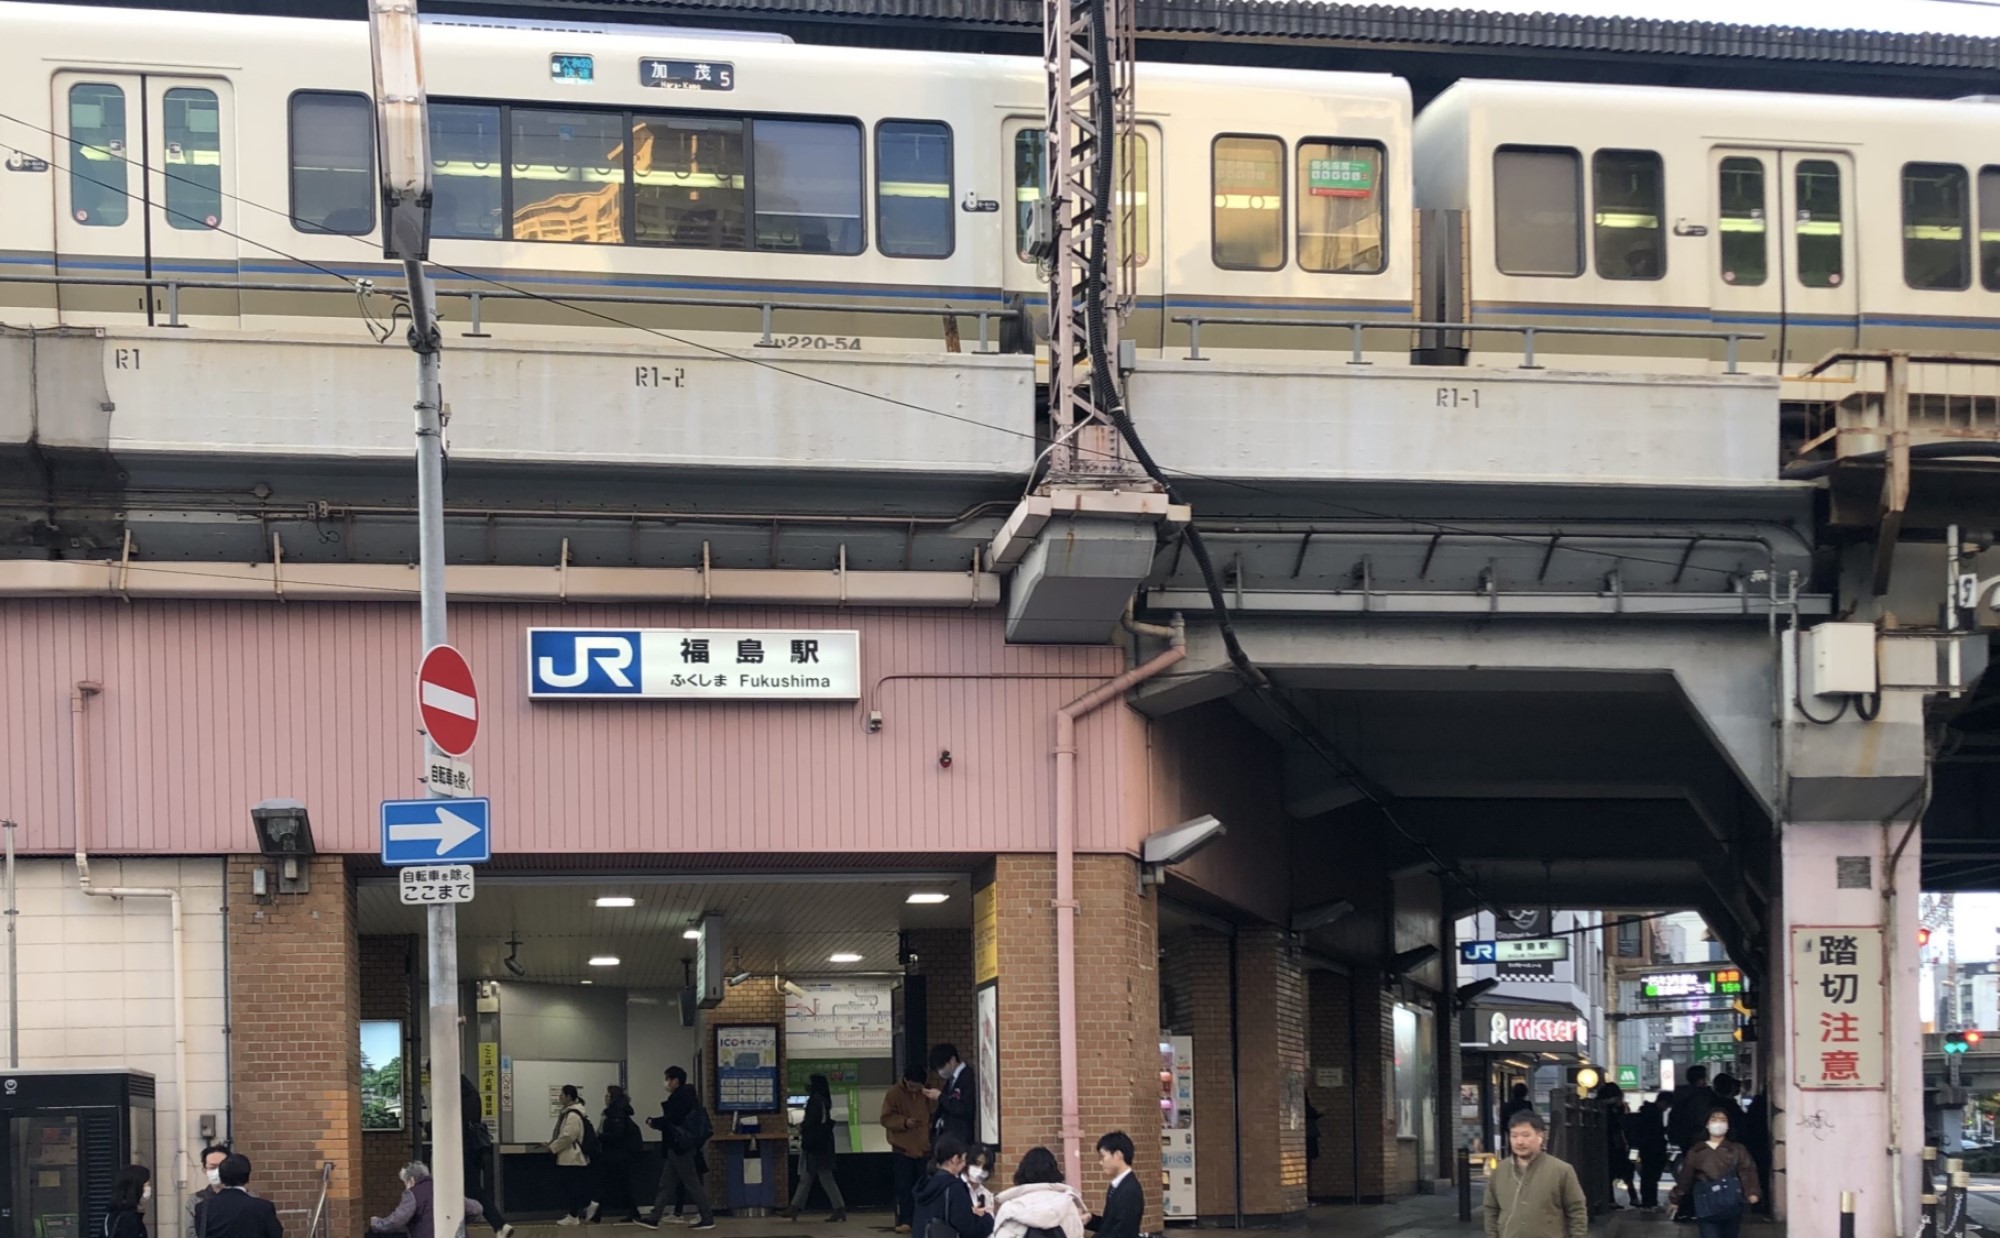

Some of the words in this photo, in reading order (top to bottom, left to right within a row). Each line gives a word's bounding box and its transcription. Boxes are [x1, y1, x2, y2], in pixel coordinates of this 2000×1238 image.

[651, 62, 712, 81] 加茂
[720, 72, 730, 87] 5
[115, 348, 140, 370] R1
[635, 366, 685, 388] R1-2
[1436, 388, 1480, 409] R1-1
[539, 636, 634, 688] JR
[680, 638, 820, 665] 福島駅
[670, 673, 728, 688] ふくしま
[739, 674, 831, 688] Fukushima
[403, 868, 471, 883] 自転車を除く
[403, 884, 471, 901] ここまで
[1464, 944, 1493, 960] JR
[1819, 935, 1860, 1081] 踏切注意
